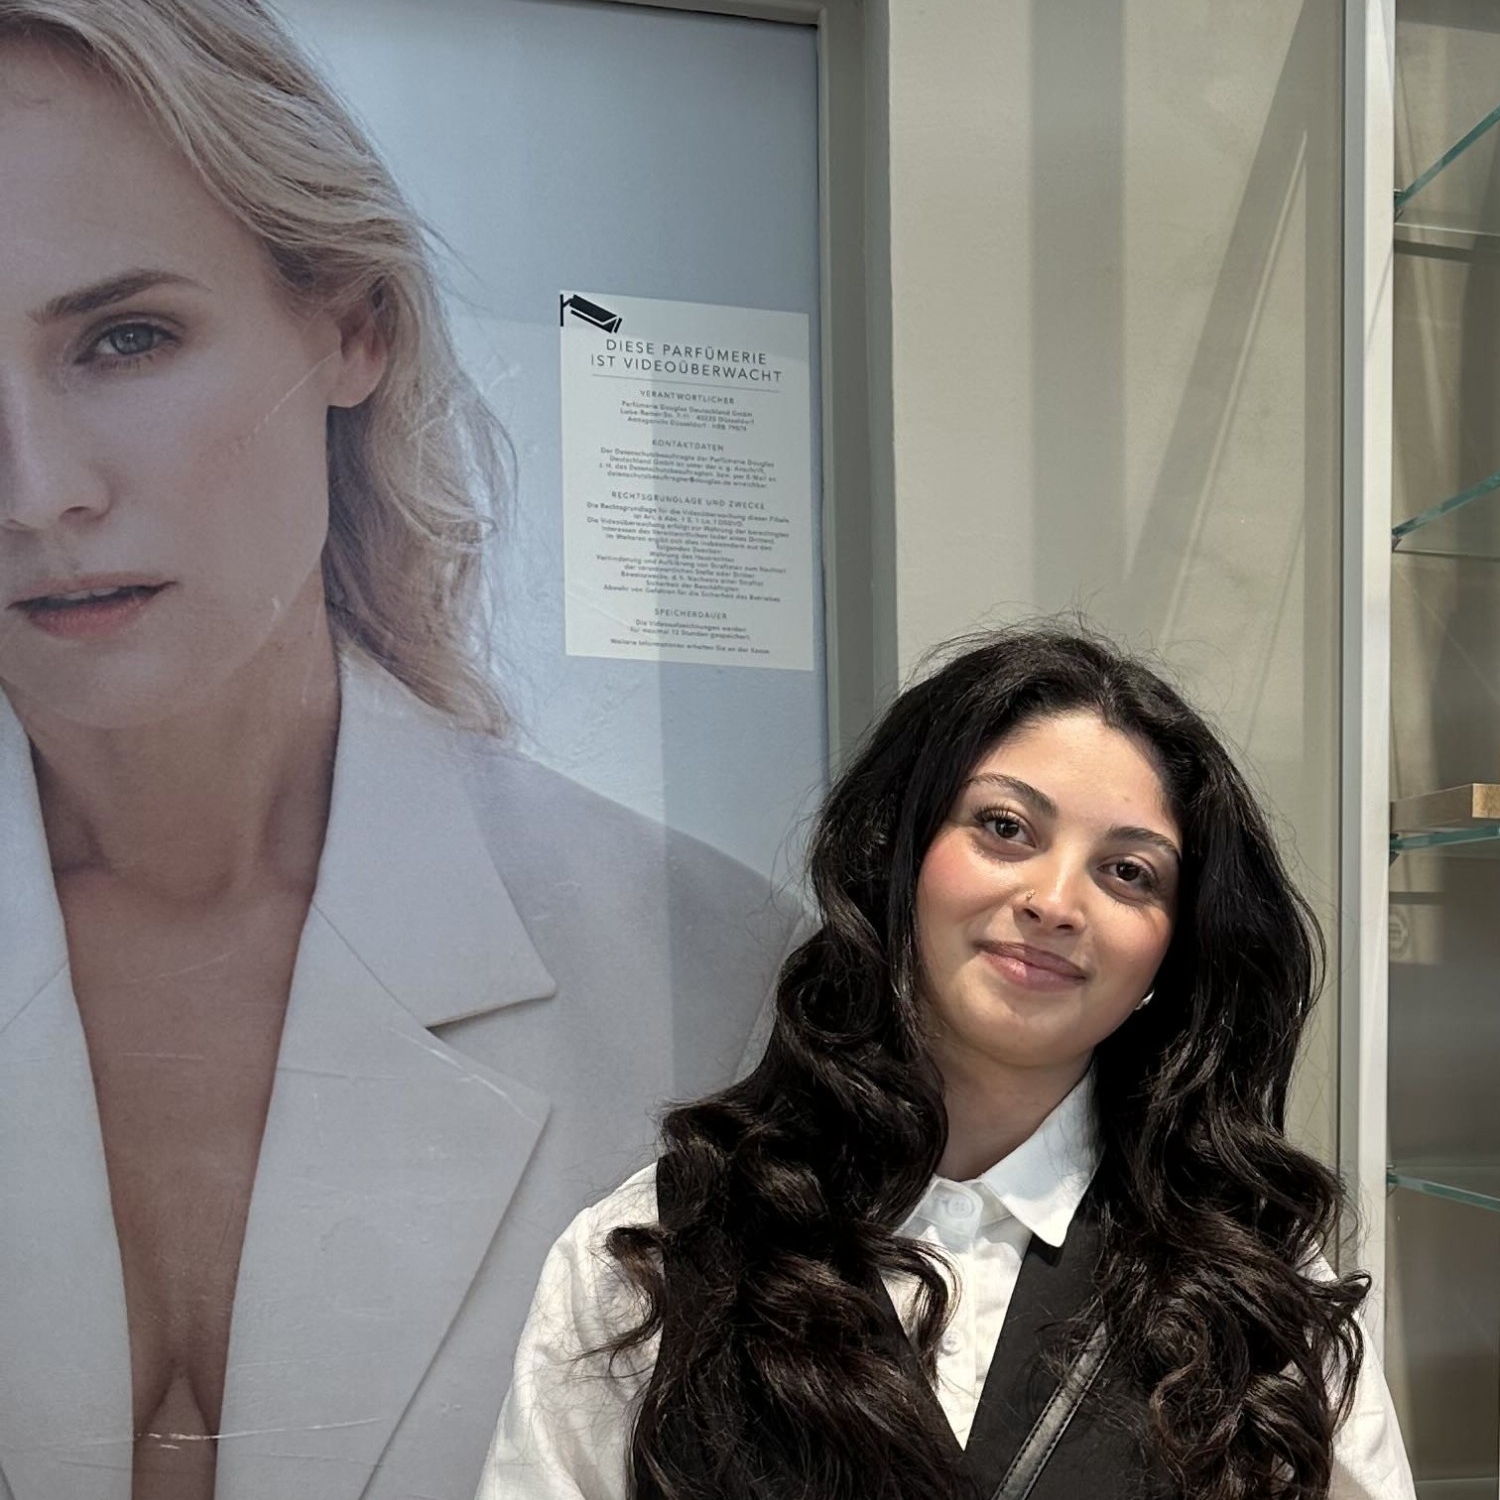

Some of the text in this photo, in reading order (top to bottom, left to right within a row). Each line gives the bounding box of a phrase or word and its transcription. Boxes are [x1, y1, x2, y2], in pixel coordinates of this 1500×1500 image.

[606, 338, 767, 365] DIESE PARFÜMERIE
[590, 353, 783, 383] IST VIDEOÜBERWACHT
[640, 389, 735, 405] VERANTWORTLICHER
[652, 438, 724, 451] KONTAKTDATEN
[611, 490, 765, 511] RECHTSGRUNDLAGE UND ZWECKE
[654, 607, 728, 620] SPEICHERDAUER
